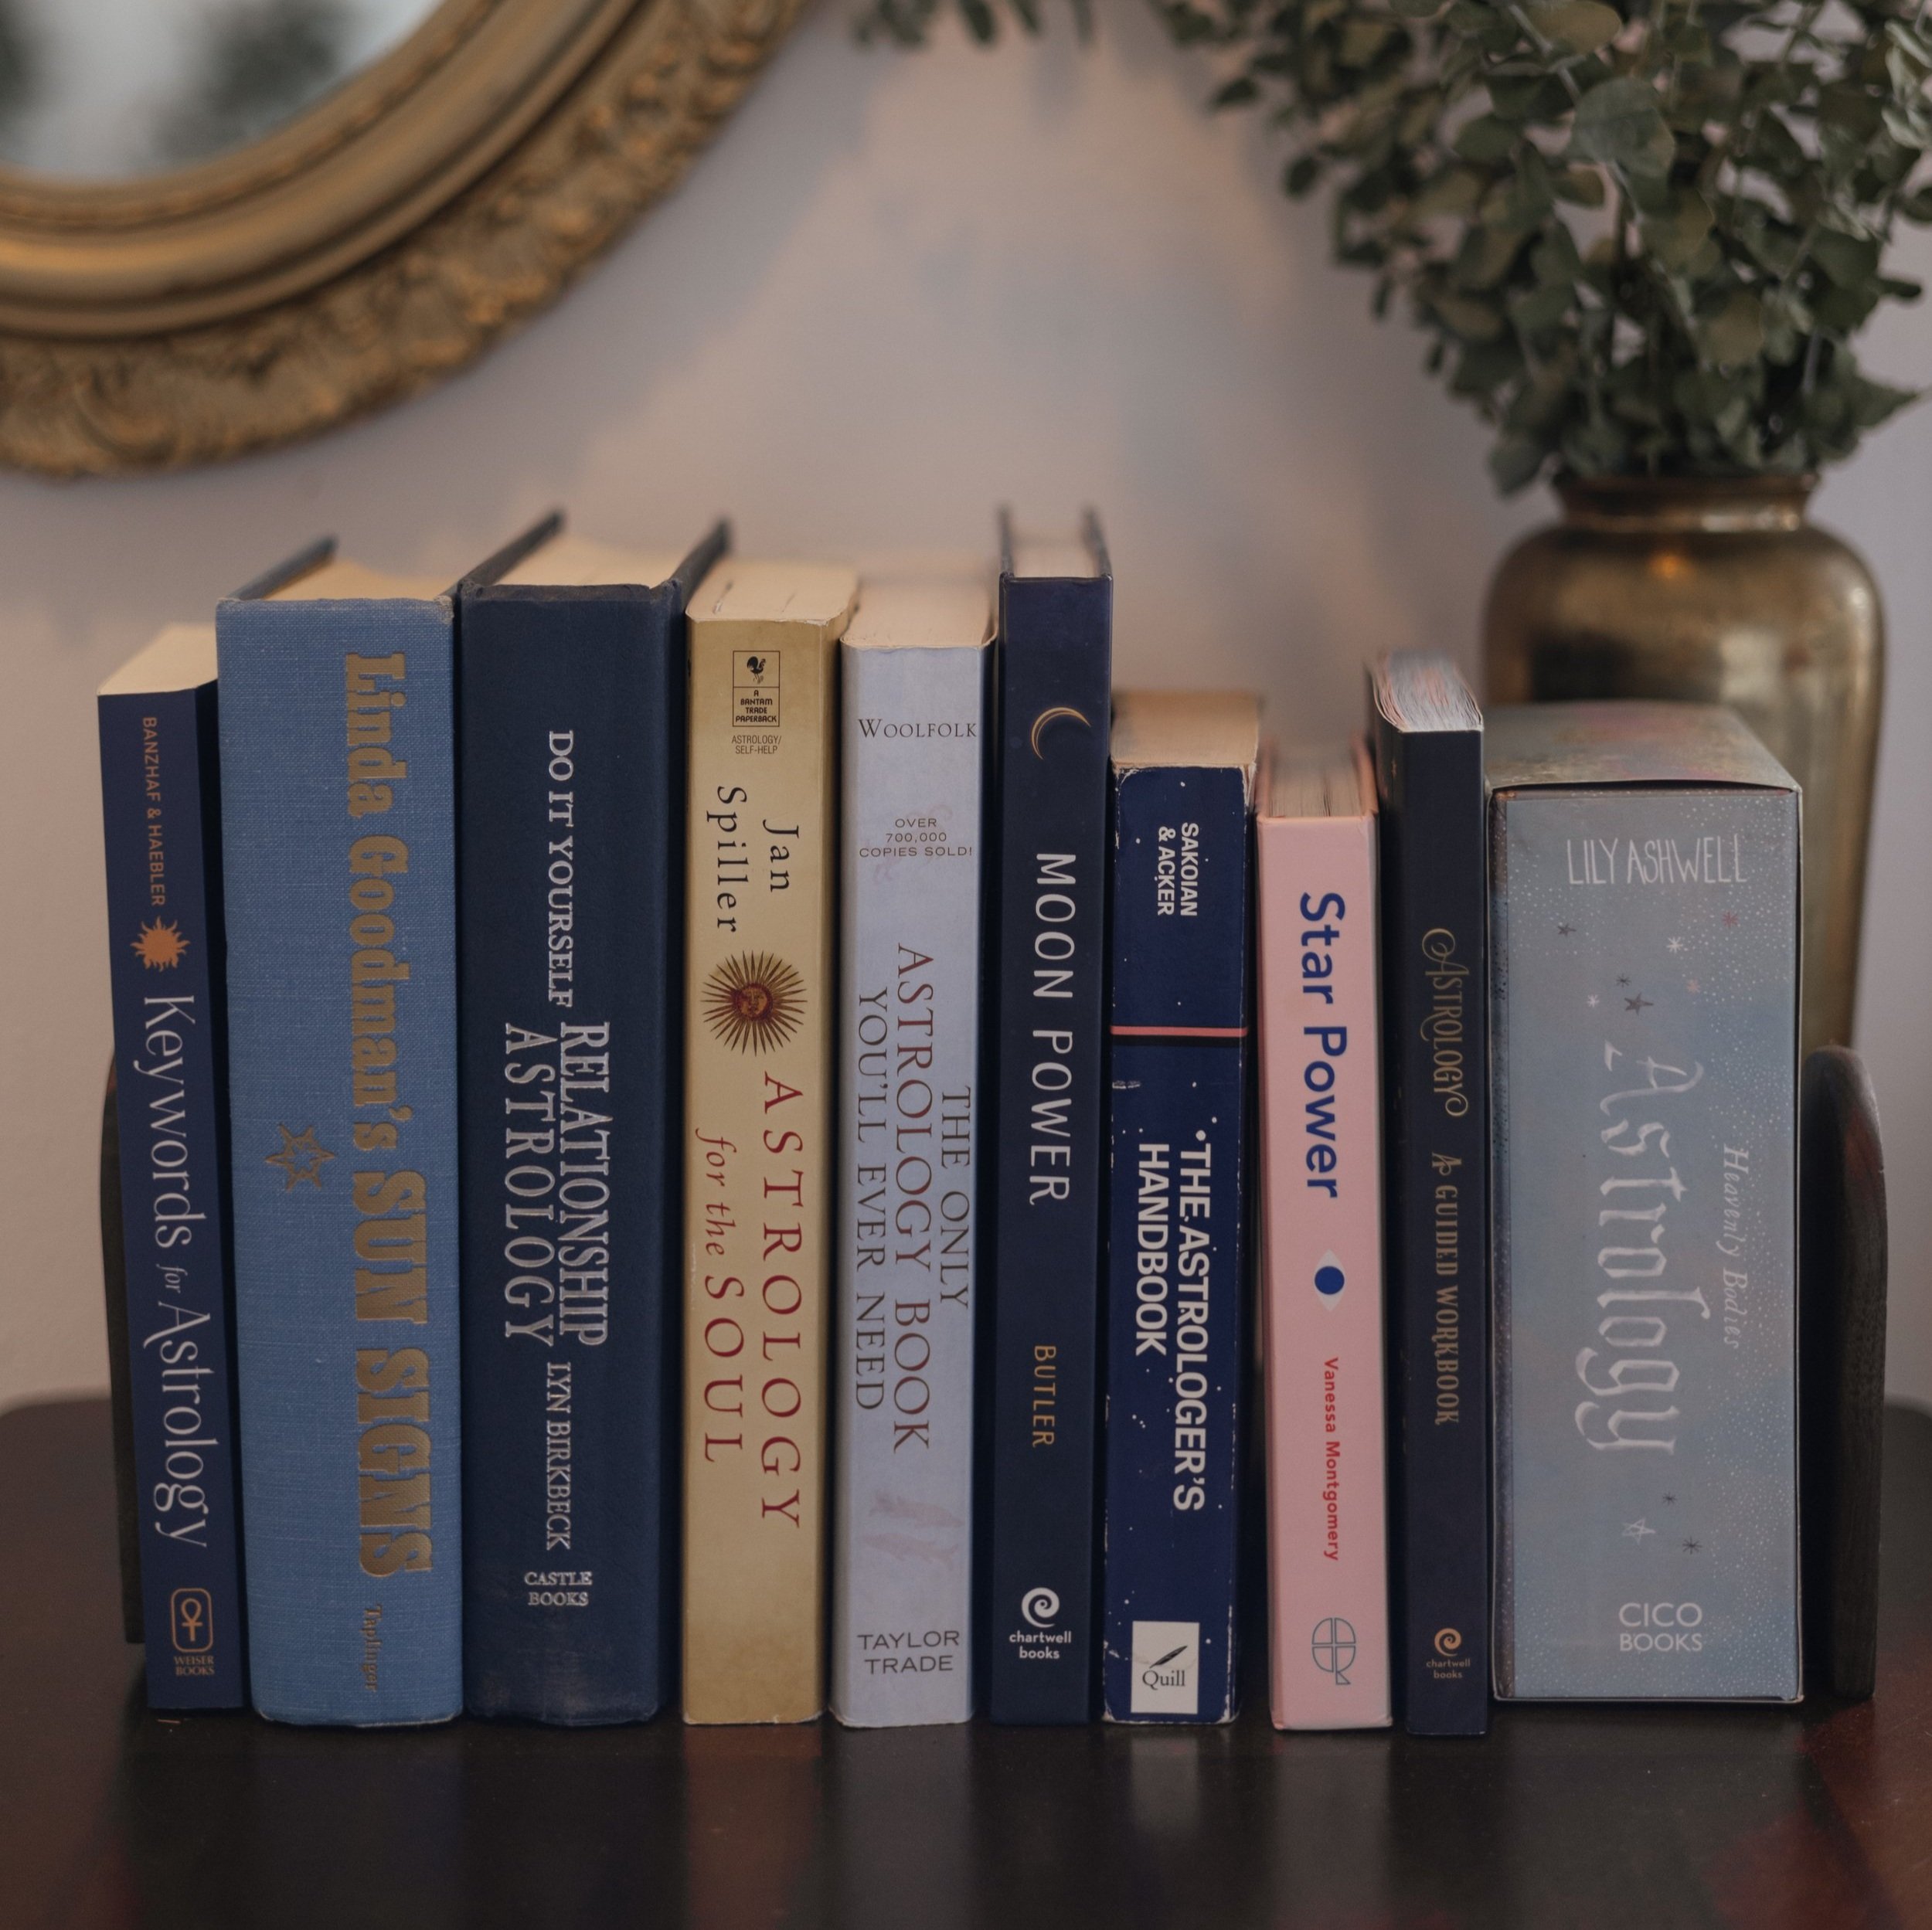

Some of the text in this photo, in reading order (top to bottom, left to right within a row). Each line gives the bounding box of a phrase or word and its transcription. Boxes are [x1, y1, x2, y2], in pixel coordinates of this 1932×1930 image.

[732, 736, 781, 745] ASTROLOGY/
[736, 746, 777, 754] SELF-HELP
[142, 716, 166, 906] BANZHAF & HAEBLER
[763, 819, 799, 892] Jan
[859, 847, 972, 857] COPIES SOLD!
[886, 832, 947, 843] 700,000
[895, 818, 937, 827] OVER
[548, 730, 574, 1007] DO IT YOURSELF
[706, 787, 748, 932] Spiller
[1158, 827, 1175, 916] & ACKER
[1180, 822, 1199, 916] SAKOIAN
[1567, 834, 1747, 885] LILY ASHWELL
[1029, 853, 1077, 1205] MOON POWER
[1300, 892, 1347, 1198] Star Power
[345, 652, 433, 1578] Linda Goodman's SUN SIGNS
[505, 1022, 557, 1347] ASTROLOGY
[560, 1021, 613, 1346] RELATIONSHIP
[855, 987, 889, 1409] YOU'LL EVER NEED
[893, 943, 934, 1453] ASTROLOGY BOOK
[940, 1086, 971, 1309] THE ONLY
[134, 994, 219, 1548] Keywords for Astrology
[1135, 1143, 1169, 1356] HANDBOOK
[1431, 1152, 1462, 1425] A GUIDED WORKBOOK
[1575, 1040, 1711, 1456] Astrology
[1716, 1143, 1750, 1349] Heavenly Bodies
[696, 1127, 744, 1463] for the SOUL
[760, 1071, 804, 1528] ASTROLOGY
[1173, 1143, 1211, 1510] THE ASTROLOGER'S
[1032, 1345, 1056, 1447] BUTLER
[546, 1361, 571, 1551] LYN BIRKBECK
[1323, 1357, 1341, 1561] Vanessa Montgomery
[524, 1572, 593, 1586] CASTLE
[528, 1592, 589, 1606] BOOKS
[1619, 1602, 1702, 1627] CICO
[174, 1656, 214, 1665] WEISER
[175, 1665, 215, 1675] BOOKS
[360, 1604, 383, 1693] Taplinger
[857, 1631, 959, 1650] TAYLOR
[865, 1656, 953, 1674] TRADE
[1009, 1630, 1071, 1643] chartwell
[1019, 1646, 1060, 1660] books
[1142, 1670, 1185, 1690] Quill
[1426, 1658, 1471, 1667] chartwell
[1434, 1670, 1463, 1679] books
[1620, 1633, 1702, 1652] BOOKS
